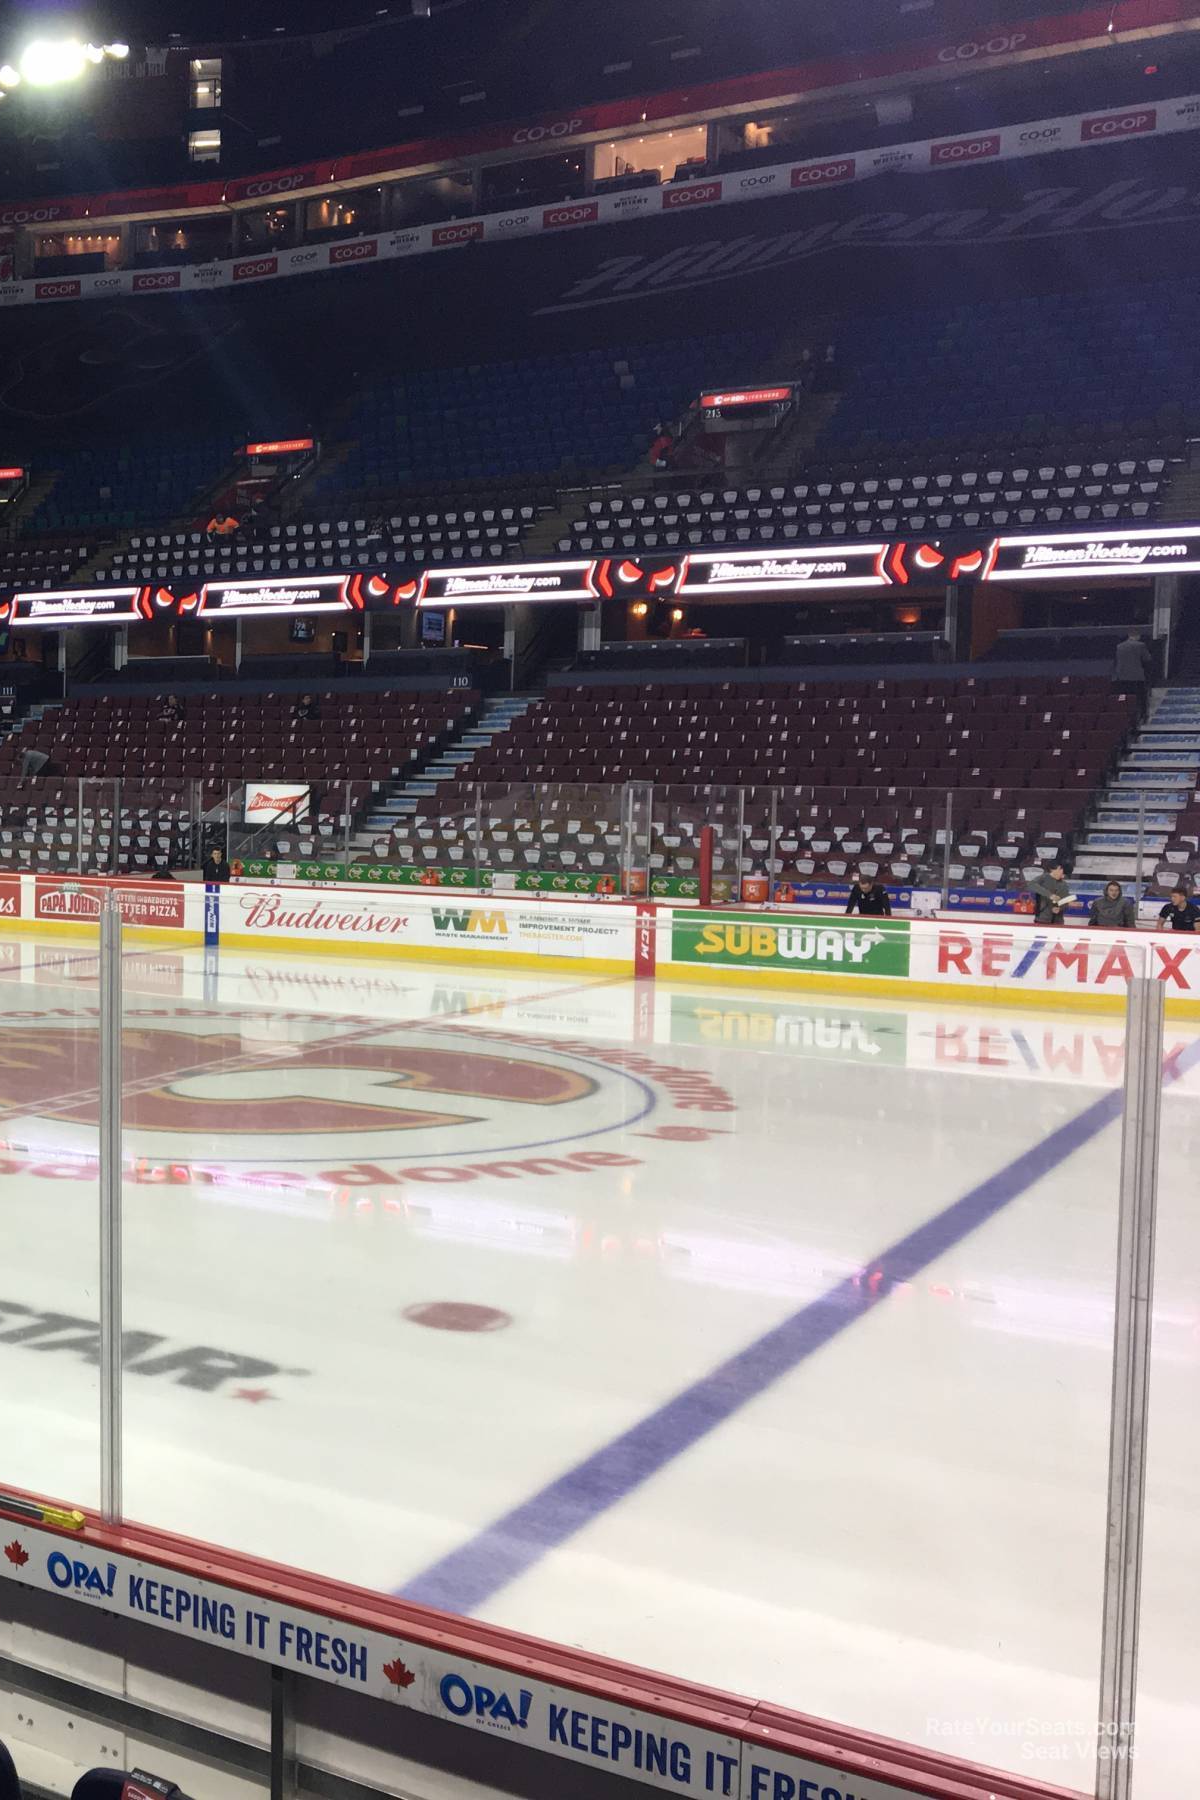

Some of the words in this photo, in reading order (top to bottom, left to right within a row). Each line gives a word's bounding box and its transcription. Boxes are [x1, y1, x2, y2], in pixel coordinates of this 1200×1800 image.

[453, 676, 469, 686] 110
[40, 891, 66, 913] PAPA
[150, 905, 179, 918] PIZZA.
[240, 892, 408, 934] Budweiser
[519, 923, 575, 932] IMPROVEMENT
[578, 927, 619, 935] PROJECT?
[640, 911, 650, 960] CCM
[695, 924, 886, 963] SUBWAY
[937, 930, 1194, 990] RE/MAX
[47, 1552, 117, 1598] OPA!
[129, 1574, 235, 1640] KEEPING
[247, 1611, 270, 1650] IT
[279, 1622, 367, 1682] FRESH
[440, 1674, 533, 1729] OPA!
[549, 1703, 691, 1785] KEEPING
[705, 1751, 739, 1797] IT
